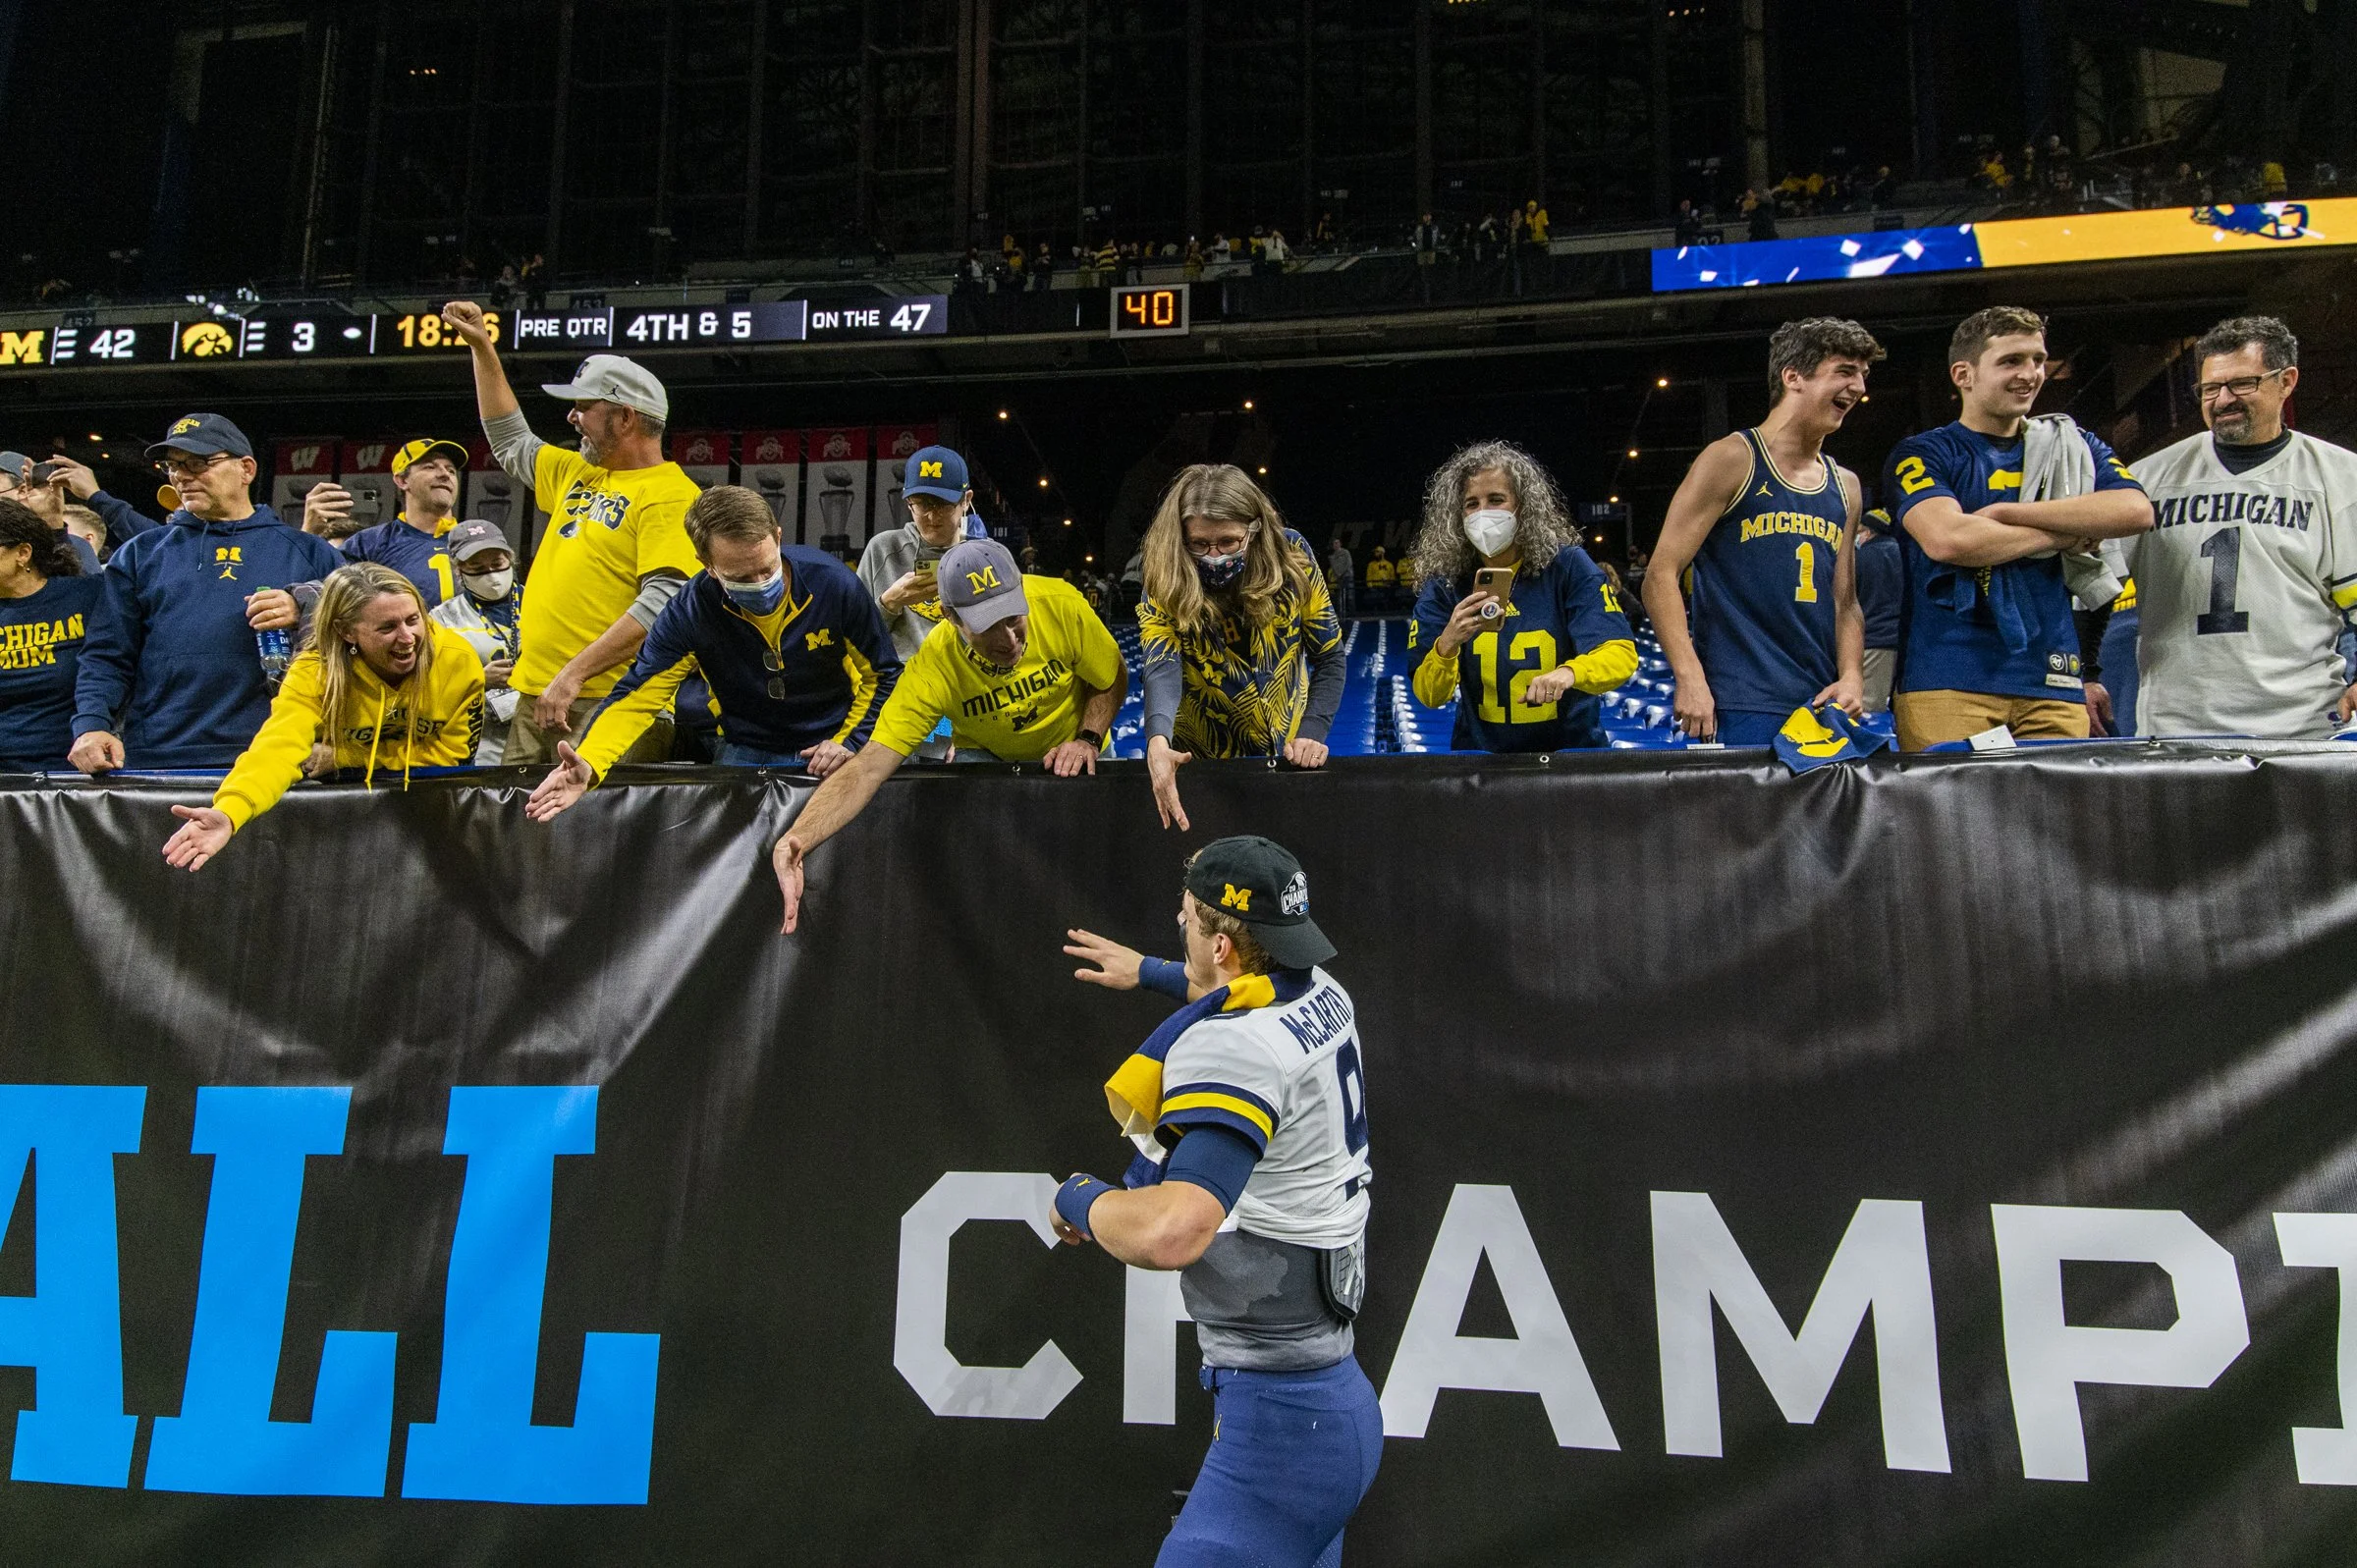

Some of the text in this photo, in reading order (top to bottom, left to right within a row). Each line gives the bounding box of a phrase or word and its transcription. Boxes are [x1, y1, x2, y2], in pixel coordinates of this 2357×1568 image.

[812, 303, 931, 331] ON THE 47
[1126, 292, 1173, 325] 40
[293, 322, 315, 352] 3
[397, 312, 500, 348] 18:6
[521, 317, 607, 338] PRE QTR
[627, 311, 751, 341] 4TH & 5
[0, 331, 44, 364] M
[89, 329, 136, 358] 42
[920, 461, 943, 478] M
[1895, 457, 1936, 495] 2
[2149, 492, 2313, 532] MICHIGAN
[216, 547, 243, 562] M
[966, 566, 1001, 595] M
[1795, 542, 1817, 603] 1
[2197, 526, 2249, 635] 1
[805, 628, 834, 651] M
[961, 659, 1067, 717] MICHIGAN
[1473, 629, 1558, 724] 12
[1012, 706, 1039, 731] M
[1221, 884, 1252, 911] M
